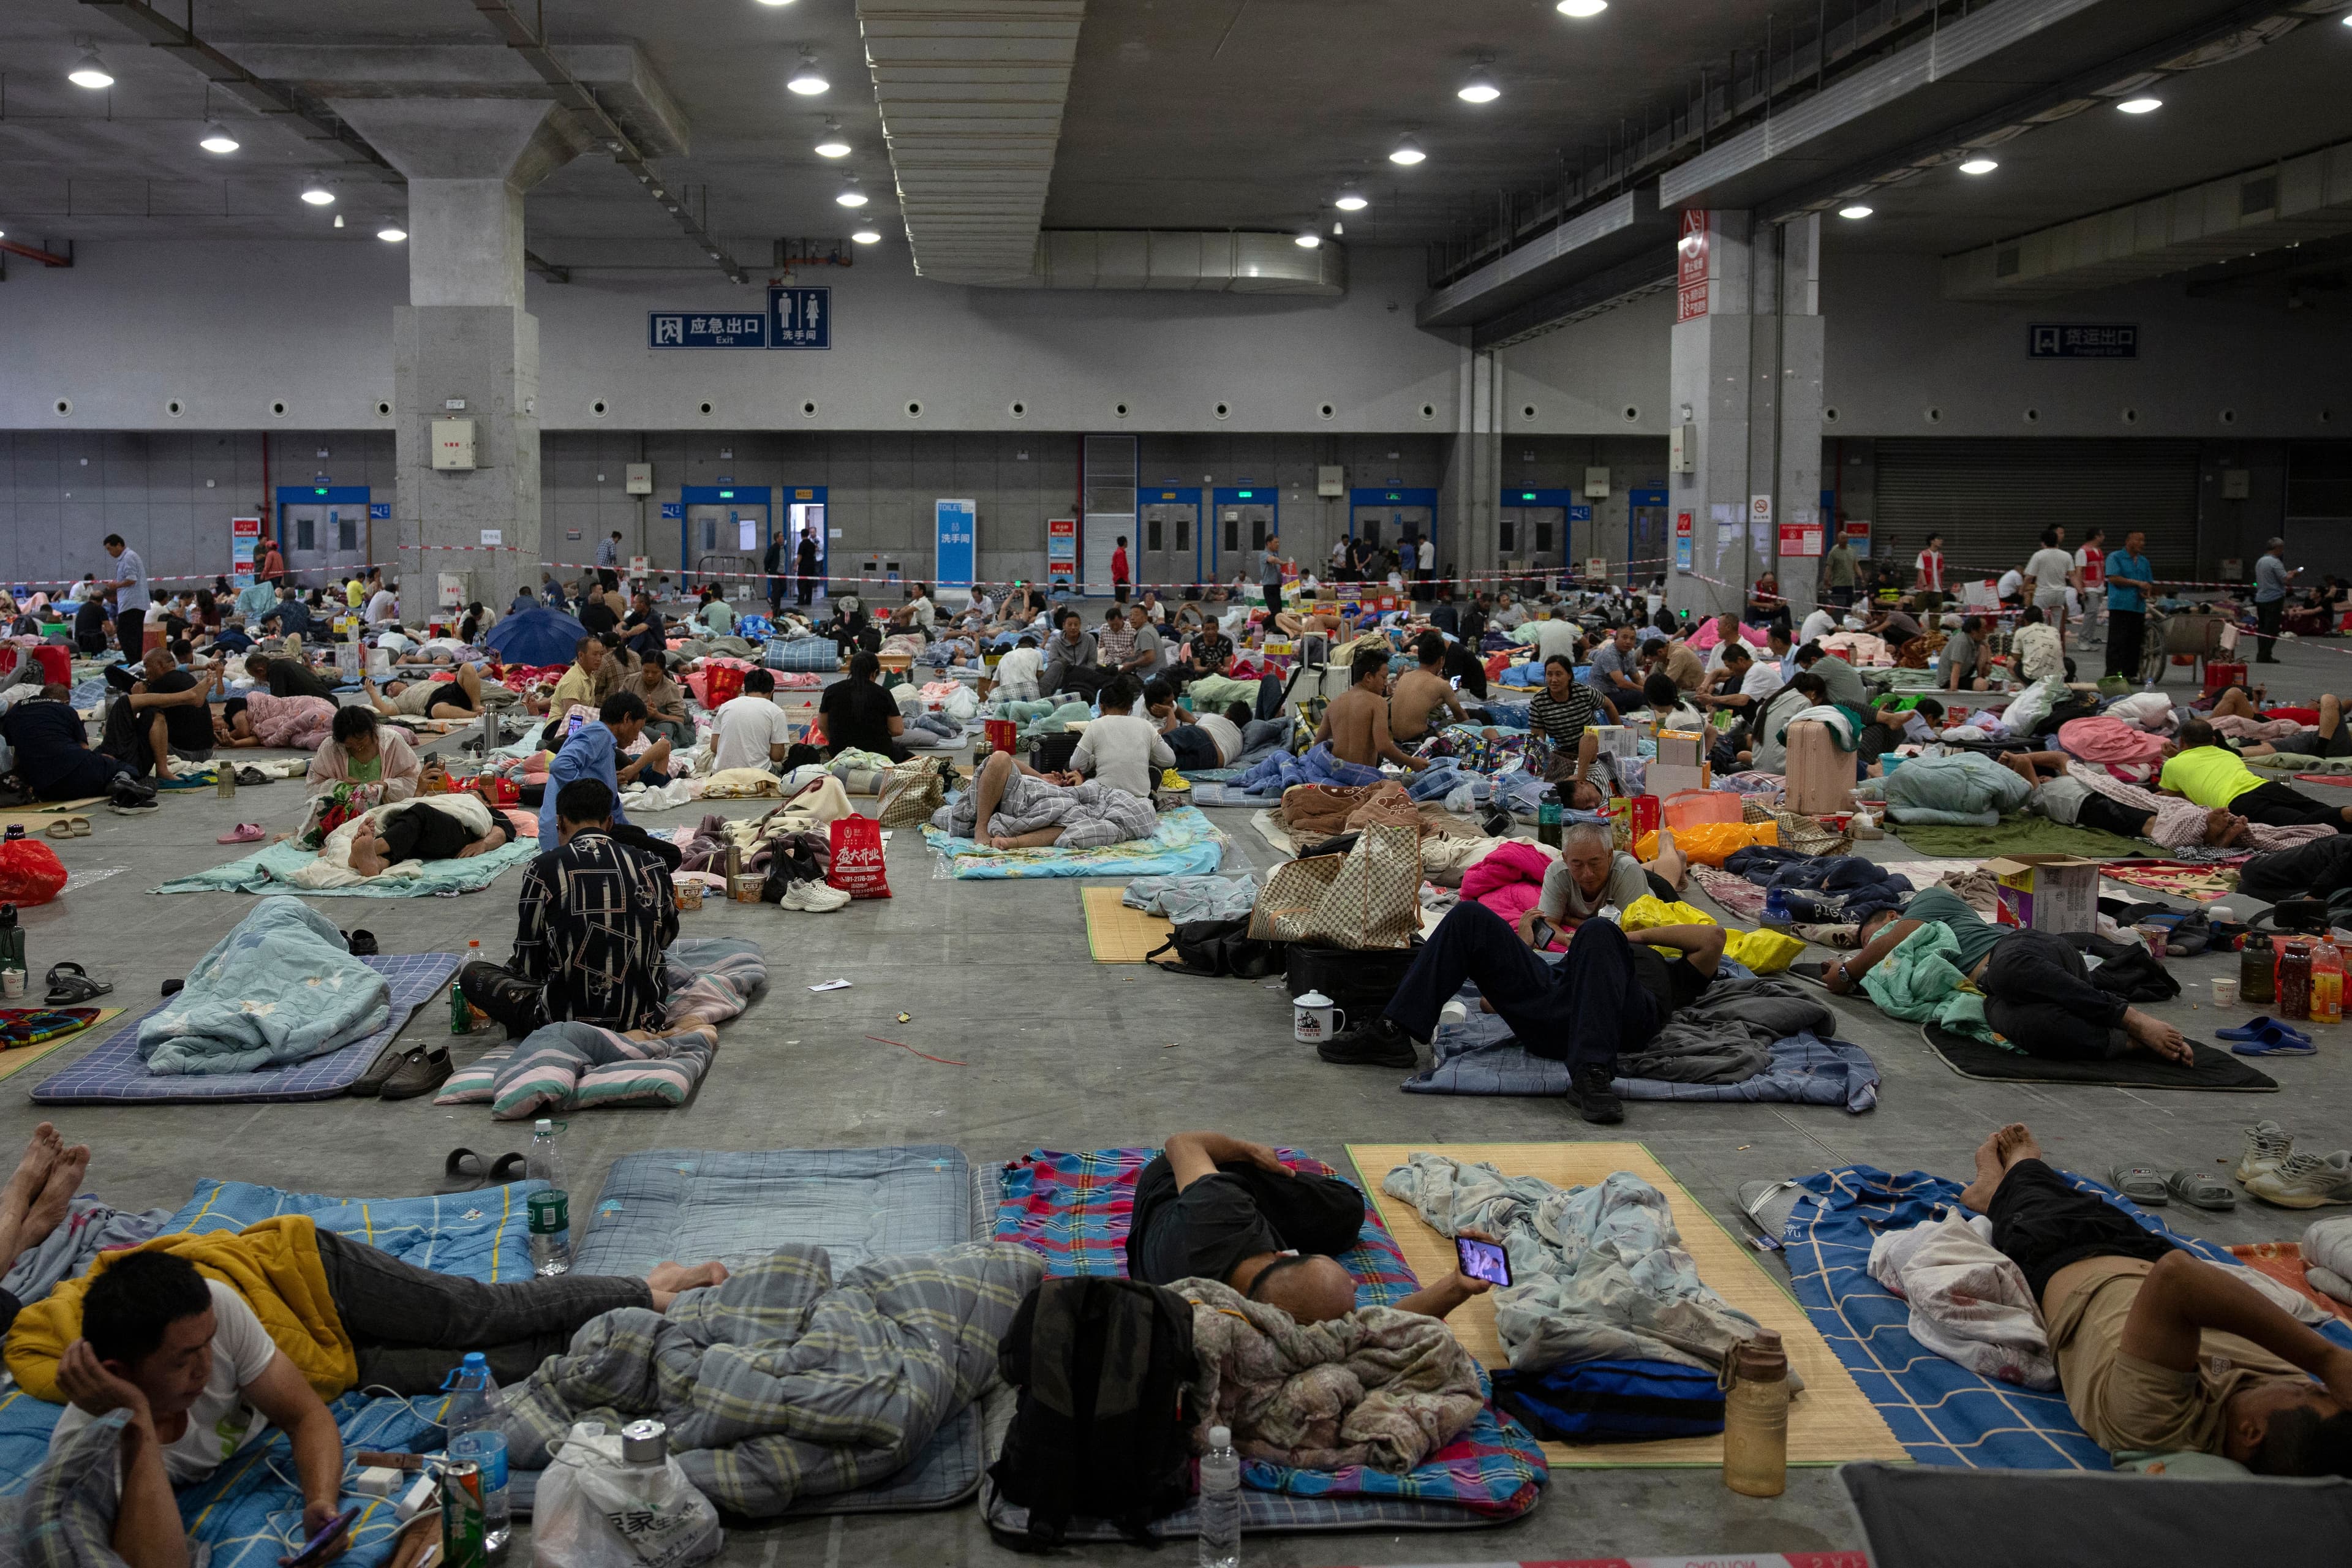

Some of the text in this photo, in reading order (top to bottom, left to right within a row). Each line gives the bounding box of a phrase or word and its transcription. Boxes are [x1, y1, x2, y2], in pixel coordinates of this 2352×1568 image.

[690, 317, 759, 334] 应急出口
[783, 330, 816, 340] 洗手间
[2065, 328, 2133, 346] 货运出口
[941, 533, 970, 543] 洗手间
[836, 846, 881, 866] 盛大开业
